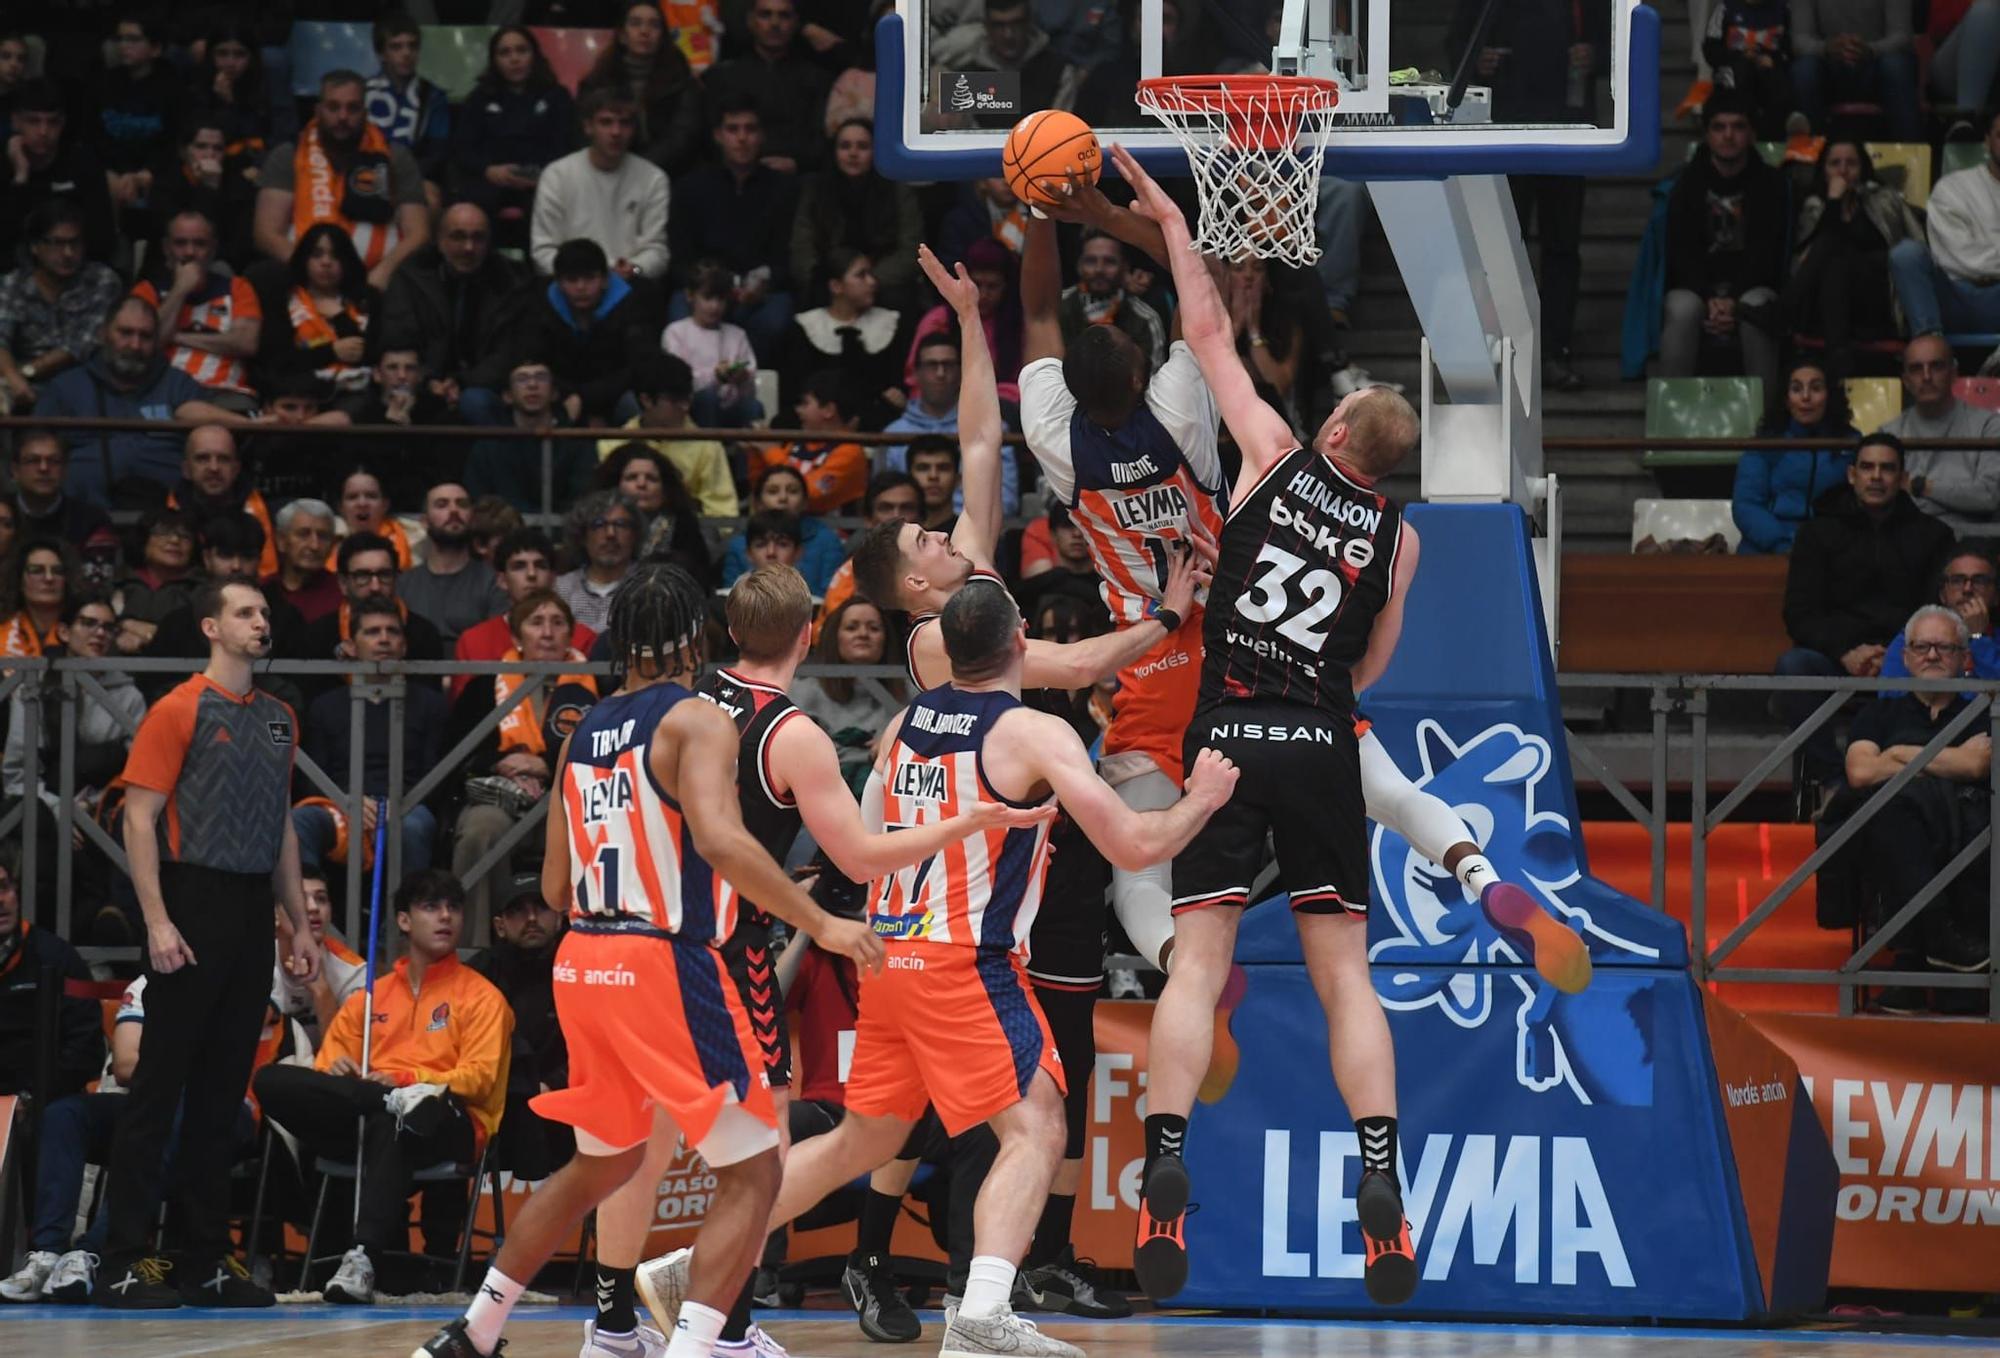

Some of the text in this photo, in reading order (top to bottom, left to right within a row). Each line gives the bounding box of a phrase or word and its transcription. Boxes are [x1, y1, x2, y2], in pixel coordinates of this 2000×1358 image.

[976, 92, 993, 101] liga
[977, 101, 1013, 109] endesa
[1112, 486, 1189, 529] LEYMA
[1286, 470, 1382, 535] HLINASON
[1234, 542, 1342, 653] 32
[1210, 723, 1333, 745] NISSAN
[887, 950, 925, 971] ancín
[584, 963, 636, 986] ancín
[1262, 1128, 1637, 1287] LEYMA
